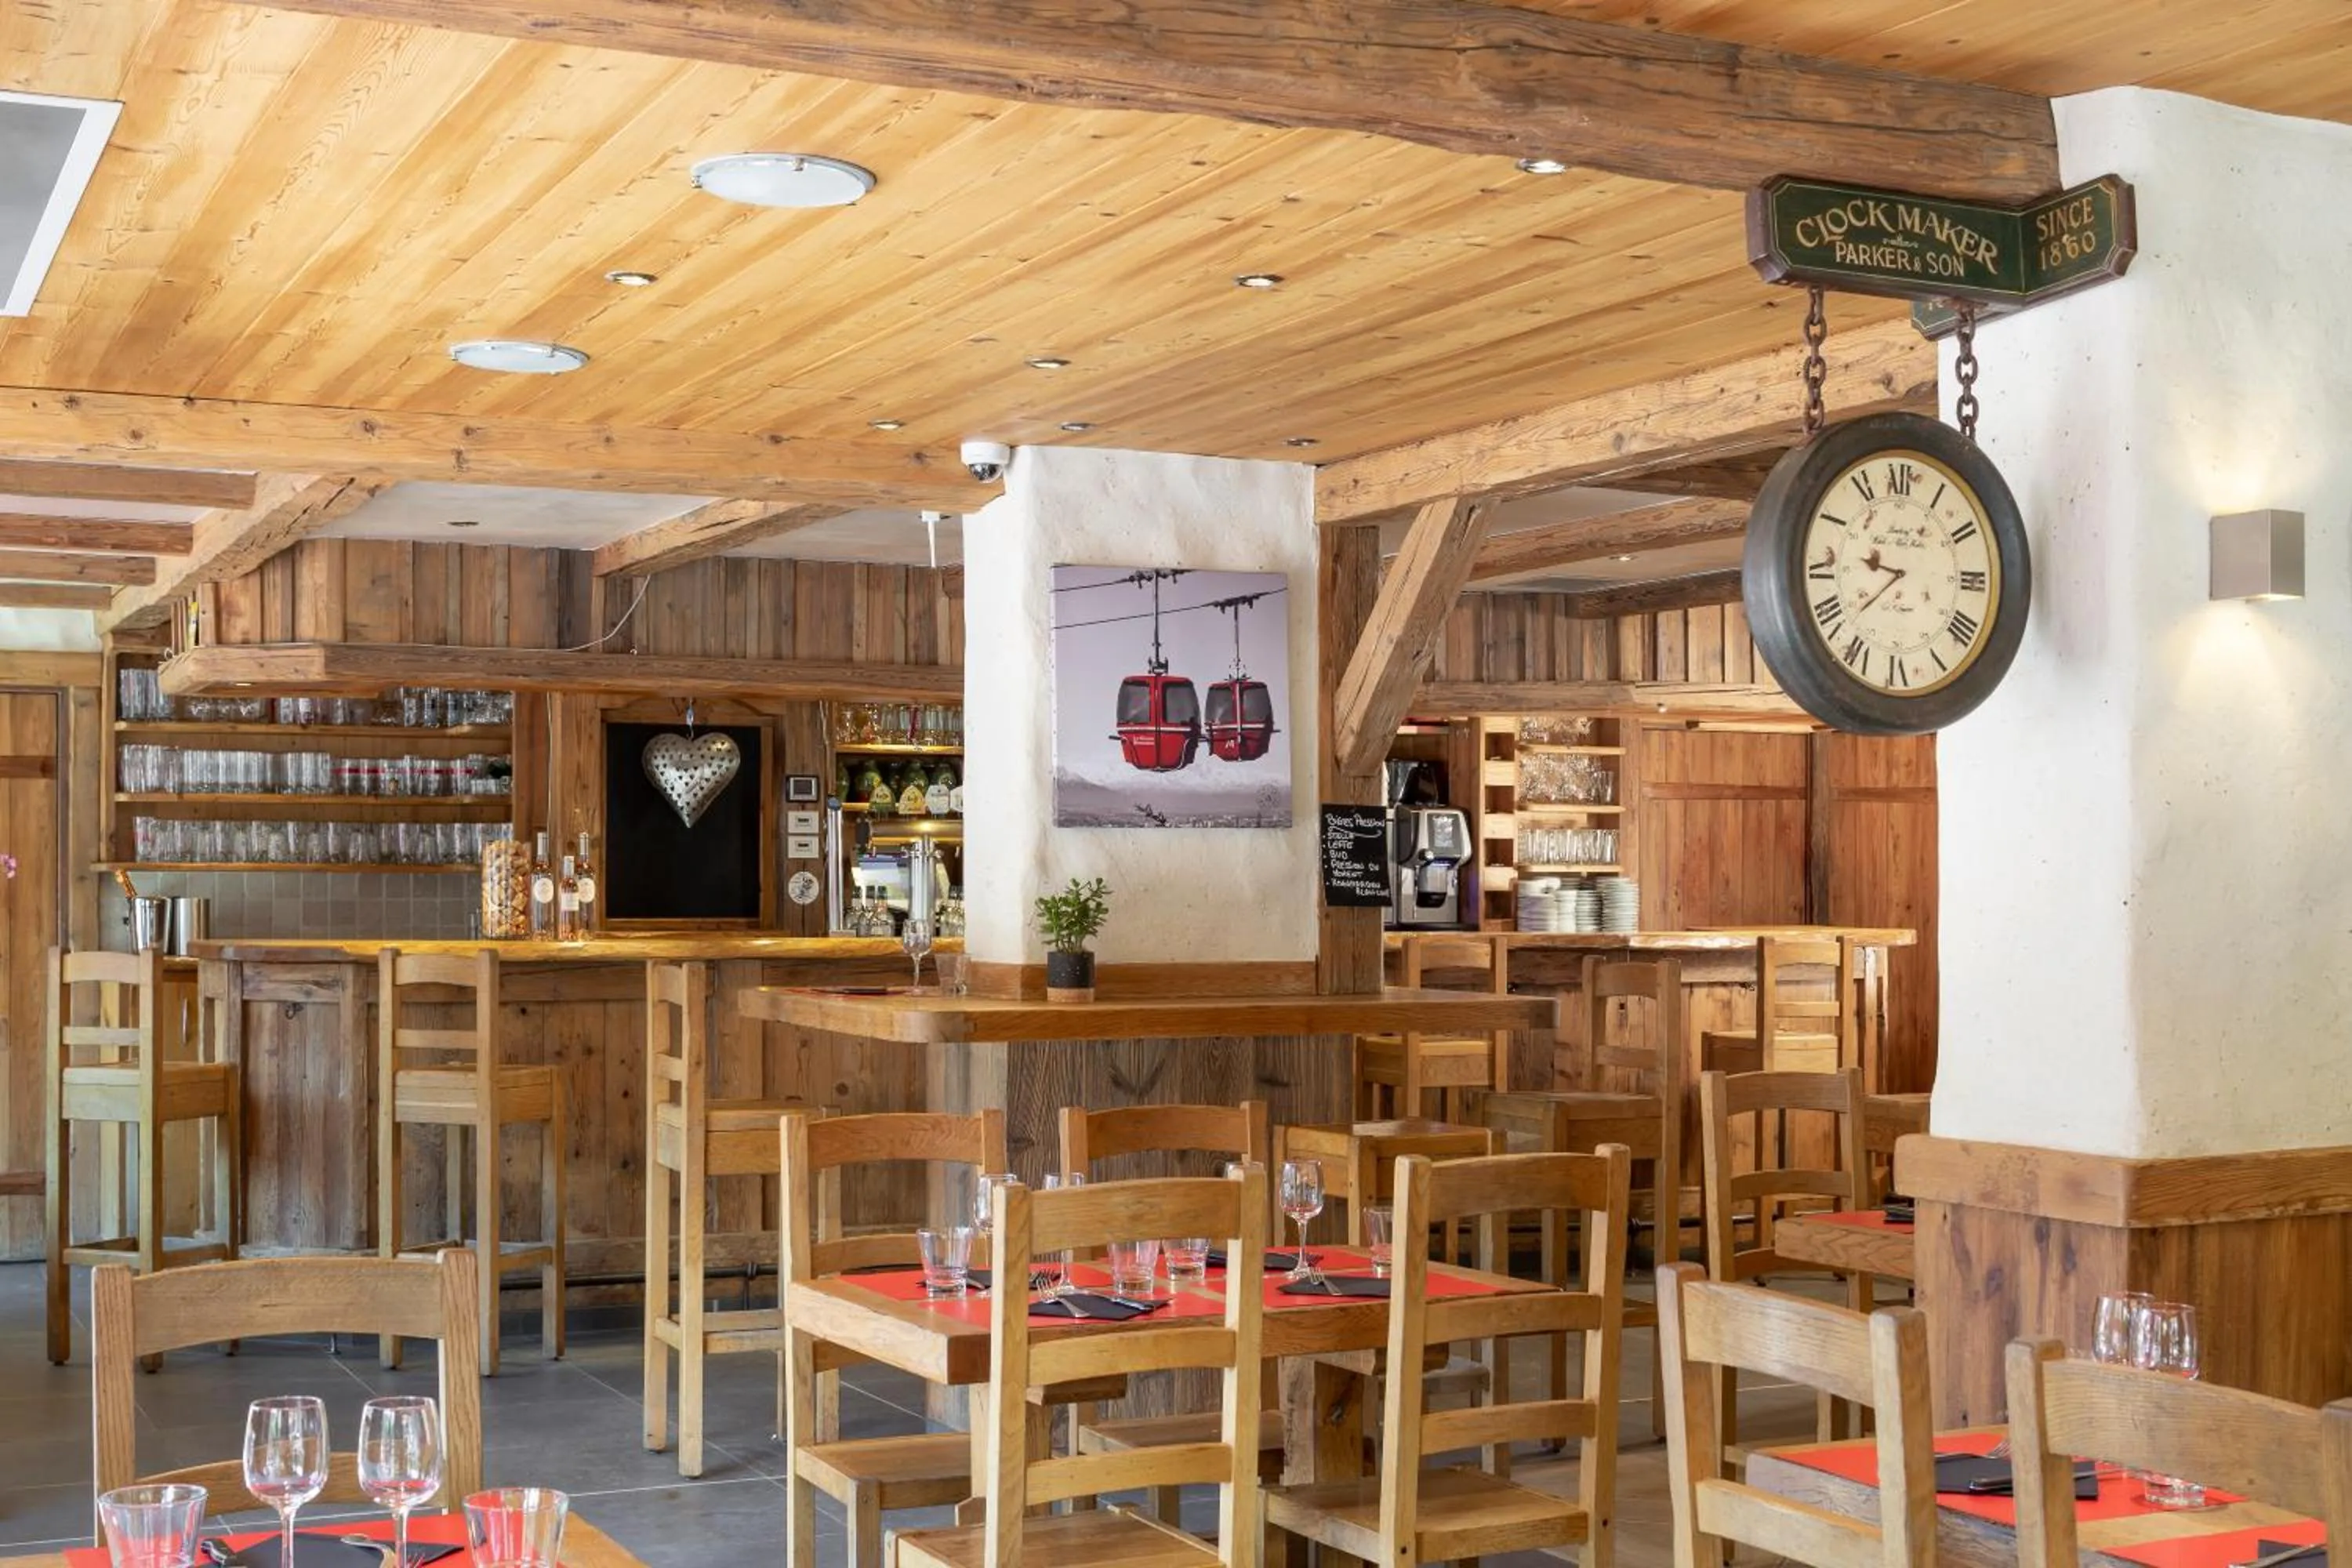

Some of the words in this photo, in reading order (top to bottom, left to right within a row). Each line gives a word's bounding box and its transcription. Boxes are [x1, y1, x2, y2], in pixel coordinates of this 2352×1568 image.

[1796, 198, 1896, 248] CLOCK
[1896, 204, 1998, 274] MAKER
[2036, 196, 2095, 241] SINCE
[1835, 241, 1912, 270] PARKER
[1926, 252, 1964, 277] SON
[2041, 230, 2096, 270] 1860
